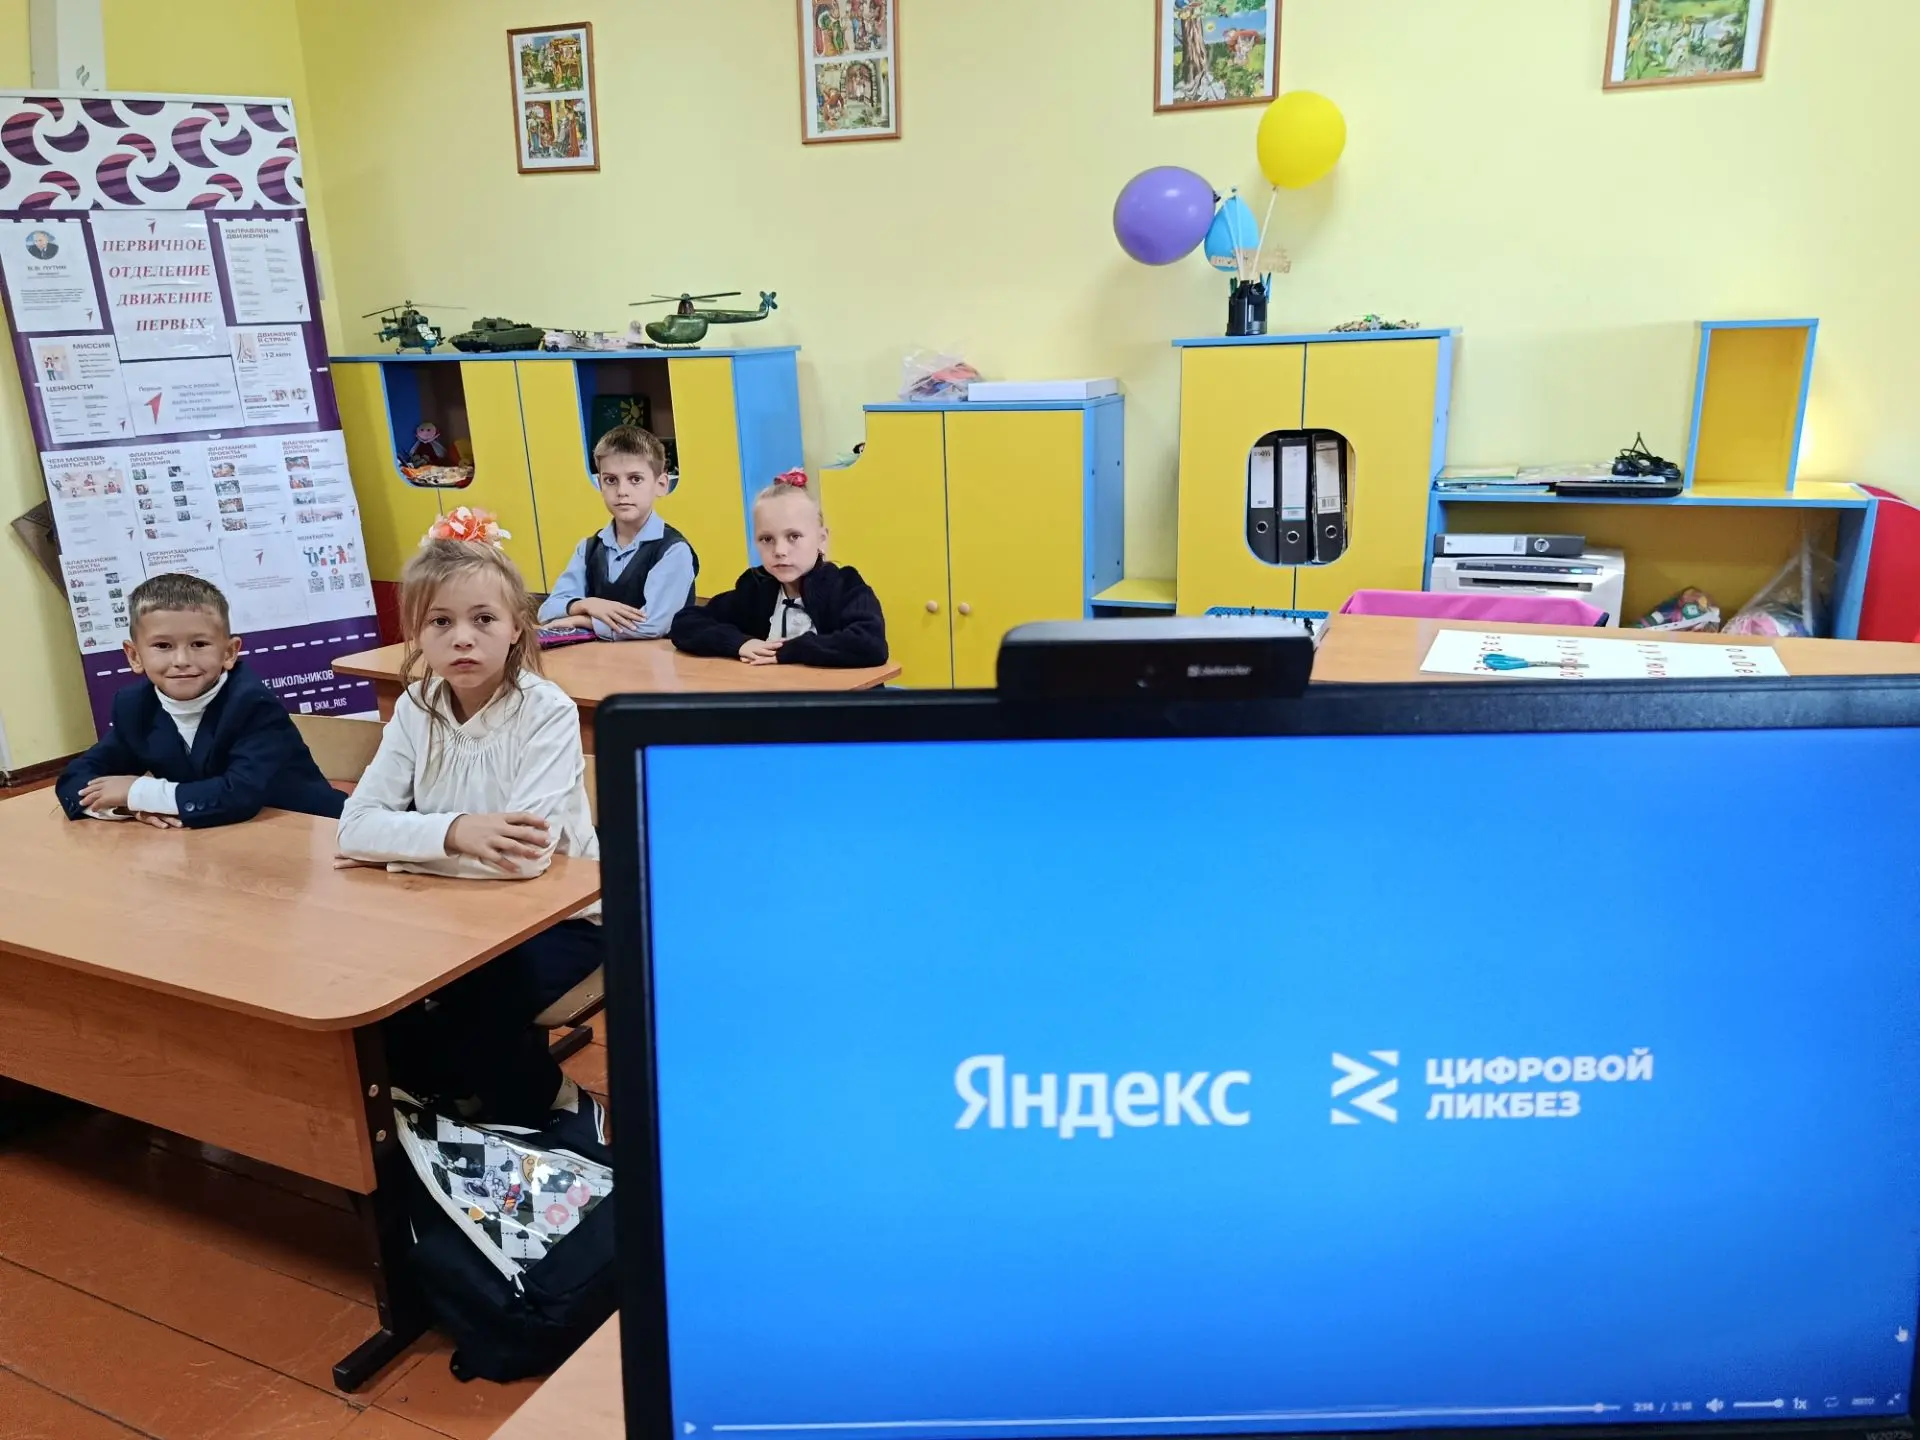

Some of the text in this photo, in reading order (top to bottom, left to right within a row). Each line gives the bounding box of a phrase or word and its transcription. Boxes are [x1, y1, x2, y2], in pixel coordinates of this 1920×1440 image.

[102, 239, 207, 252] ПЕРВИЧНОЕ
[109, 264, 211, 280] ОТДЕЛЕНИЕ
[116, 291, 213, 307] ДВИЖЕНИЕ
[136, 317, 208, 332] ПЕРВЫХ
[46, 384, 94, 392] ЦЕННОСТИ
[272, 669, 335, 689] ШКОЛЬНИКОВ
[314, 697, 347, 711] SKM_RUS
[1425, 1047, 1654, 1089] ЦИФРОВОЙ
[954, 1054, 1252, 1139] Яндекс
[1425, 1090, 1581, 1120] ЛИКБЕЗ
[1793, 1396, 1807, 1410] 1x
